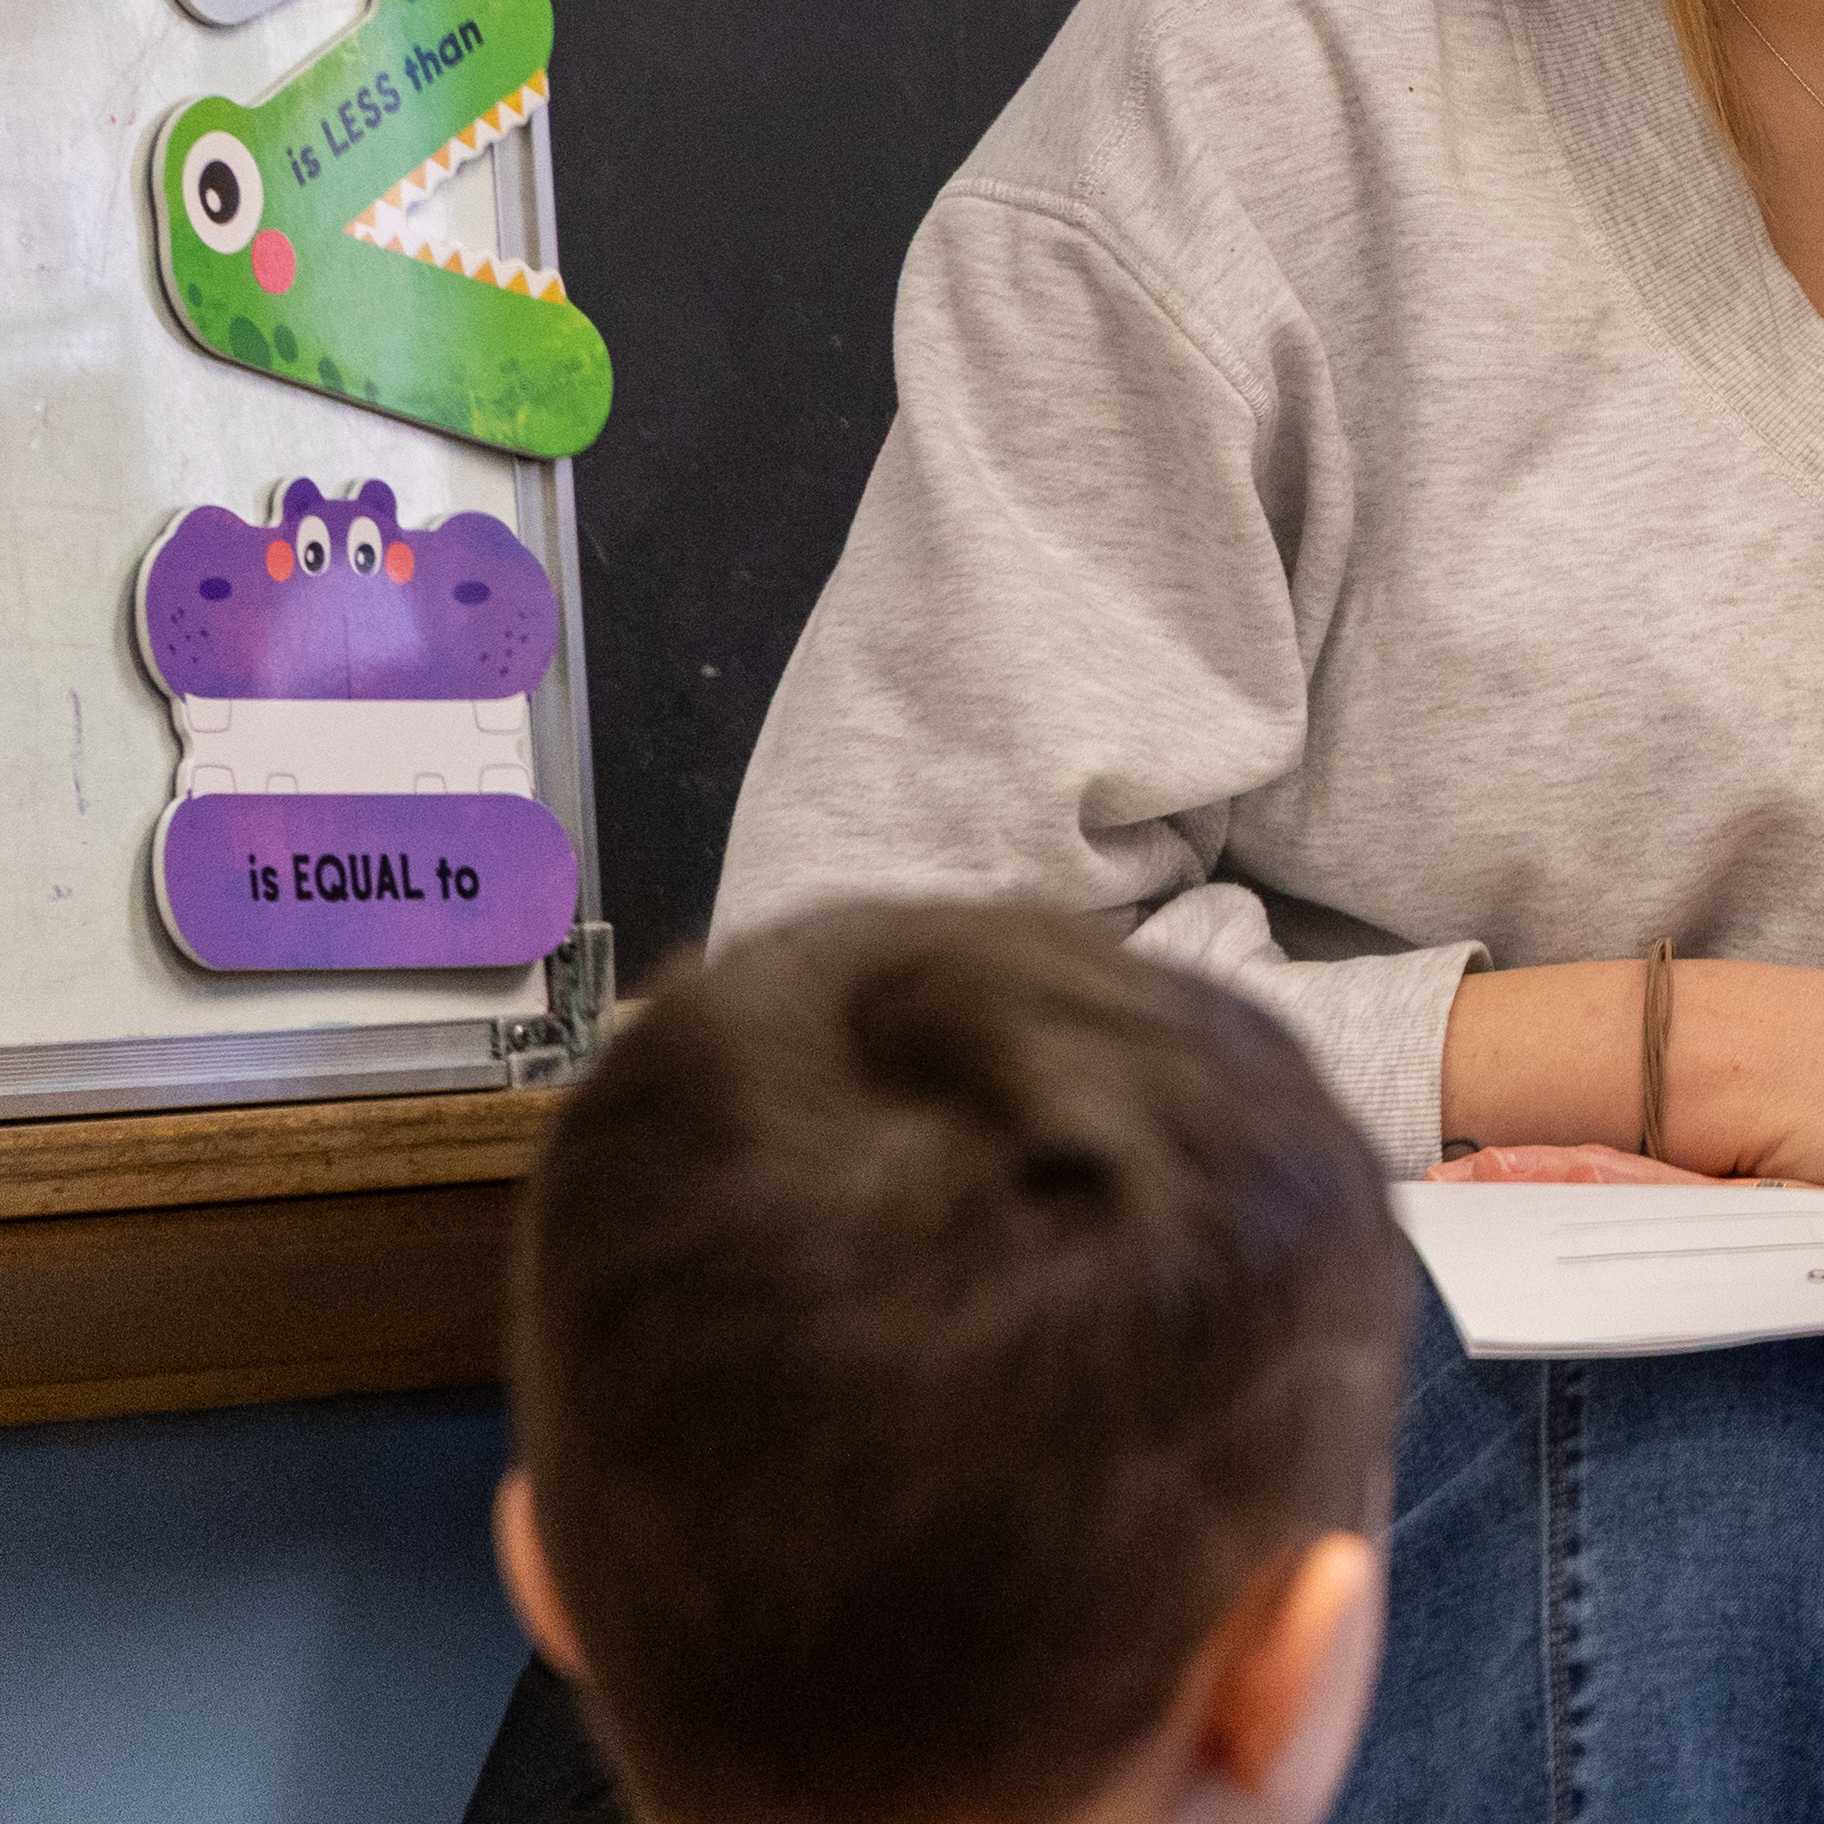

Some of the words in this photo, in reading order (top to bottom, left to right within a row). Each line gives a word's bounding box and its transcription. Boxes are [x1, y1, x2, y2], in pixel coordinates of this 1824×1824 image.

[285, 146, 321, 187] is
[320, 71, 402, 163] LESS
[403, 18, 484, 94] than
[249, 854, 280, 903] is
[292, 853, 424, 903] EQUAL
[435, 856, 481, 901] to
